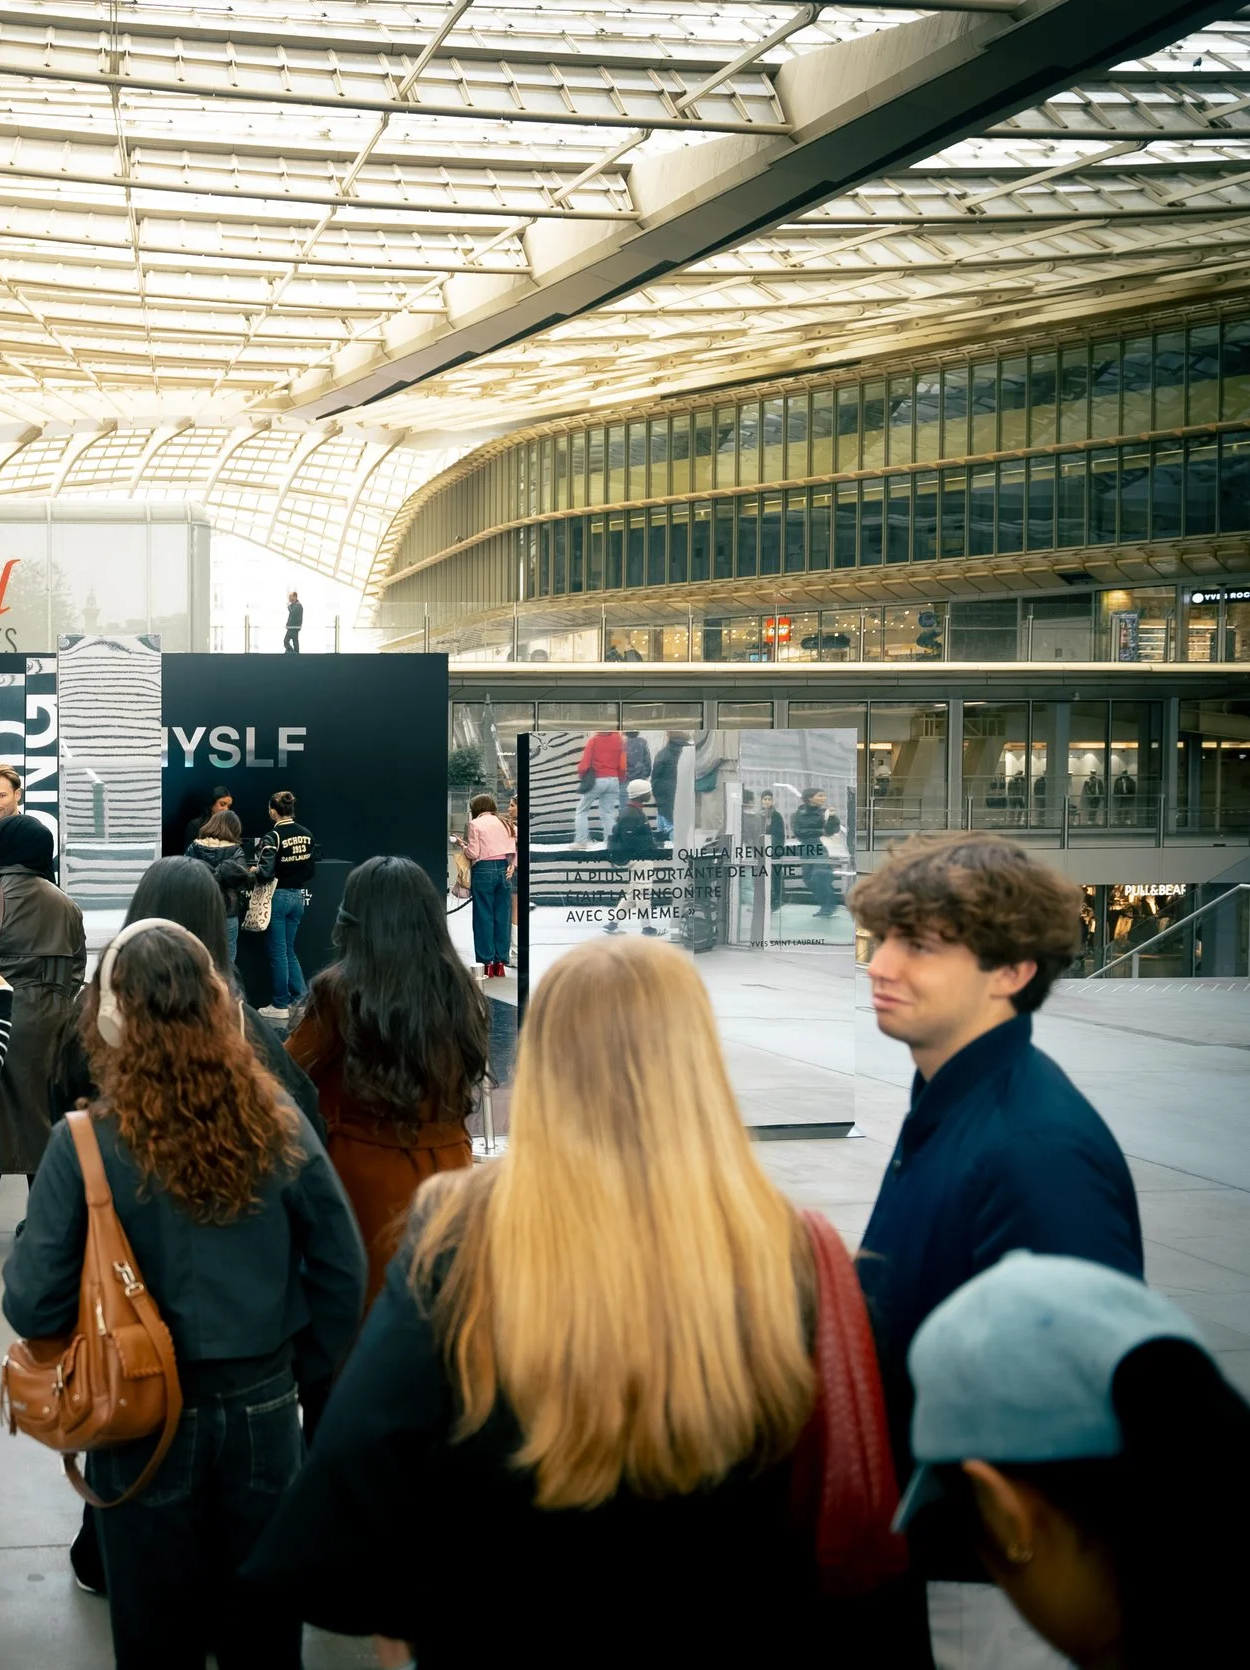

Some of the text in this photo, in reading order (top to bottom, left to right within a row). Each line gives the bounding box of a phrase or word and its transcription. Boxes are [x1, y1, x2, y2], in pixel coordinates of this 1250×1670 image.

[161, 725, 307, 769] YSLF
[282, 836, 311, 849] SCHOTT
[292, 845, 307, 854] 1913
[678, 848, 707, 864] QUE
[712, 847, 731, 859] LA
[735, 844, 824, 859] RENCONTRE
[629, 866, 723, 882] IMPORTANTE
[728, 866, 746, 878] DE
[752, 866, 769, 878] LA
[774, 864, 796, 877] VIE
[632, 886, 722, 901] RENCONTRE
[566, 909, 603, 923] AVEC
[607, 903, 685, 921] SOI-MÊME.
[751, 938, 826, 948] YVES SAINT LAURENT
